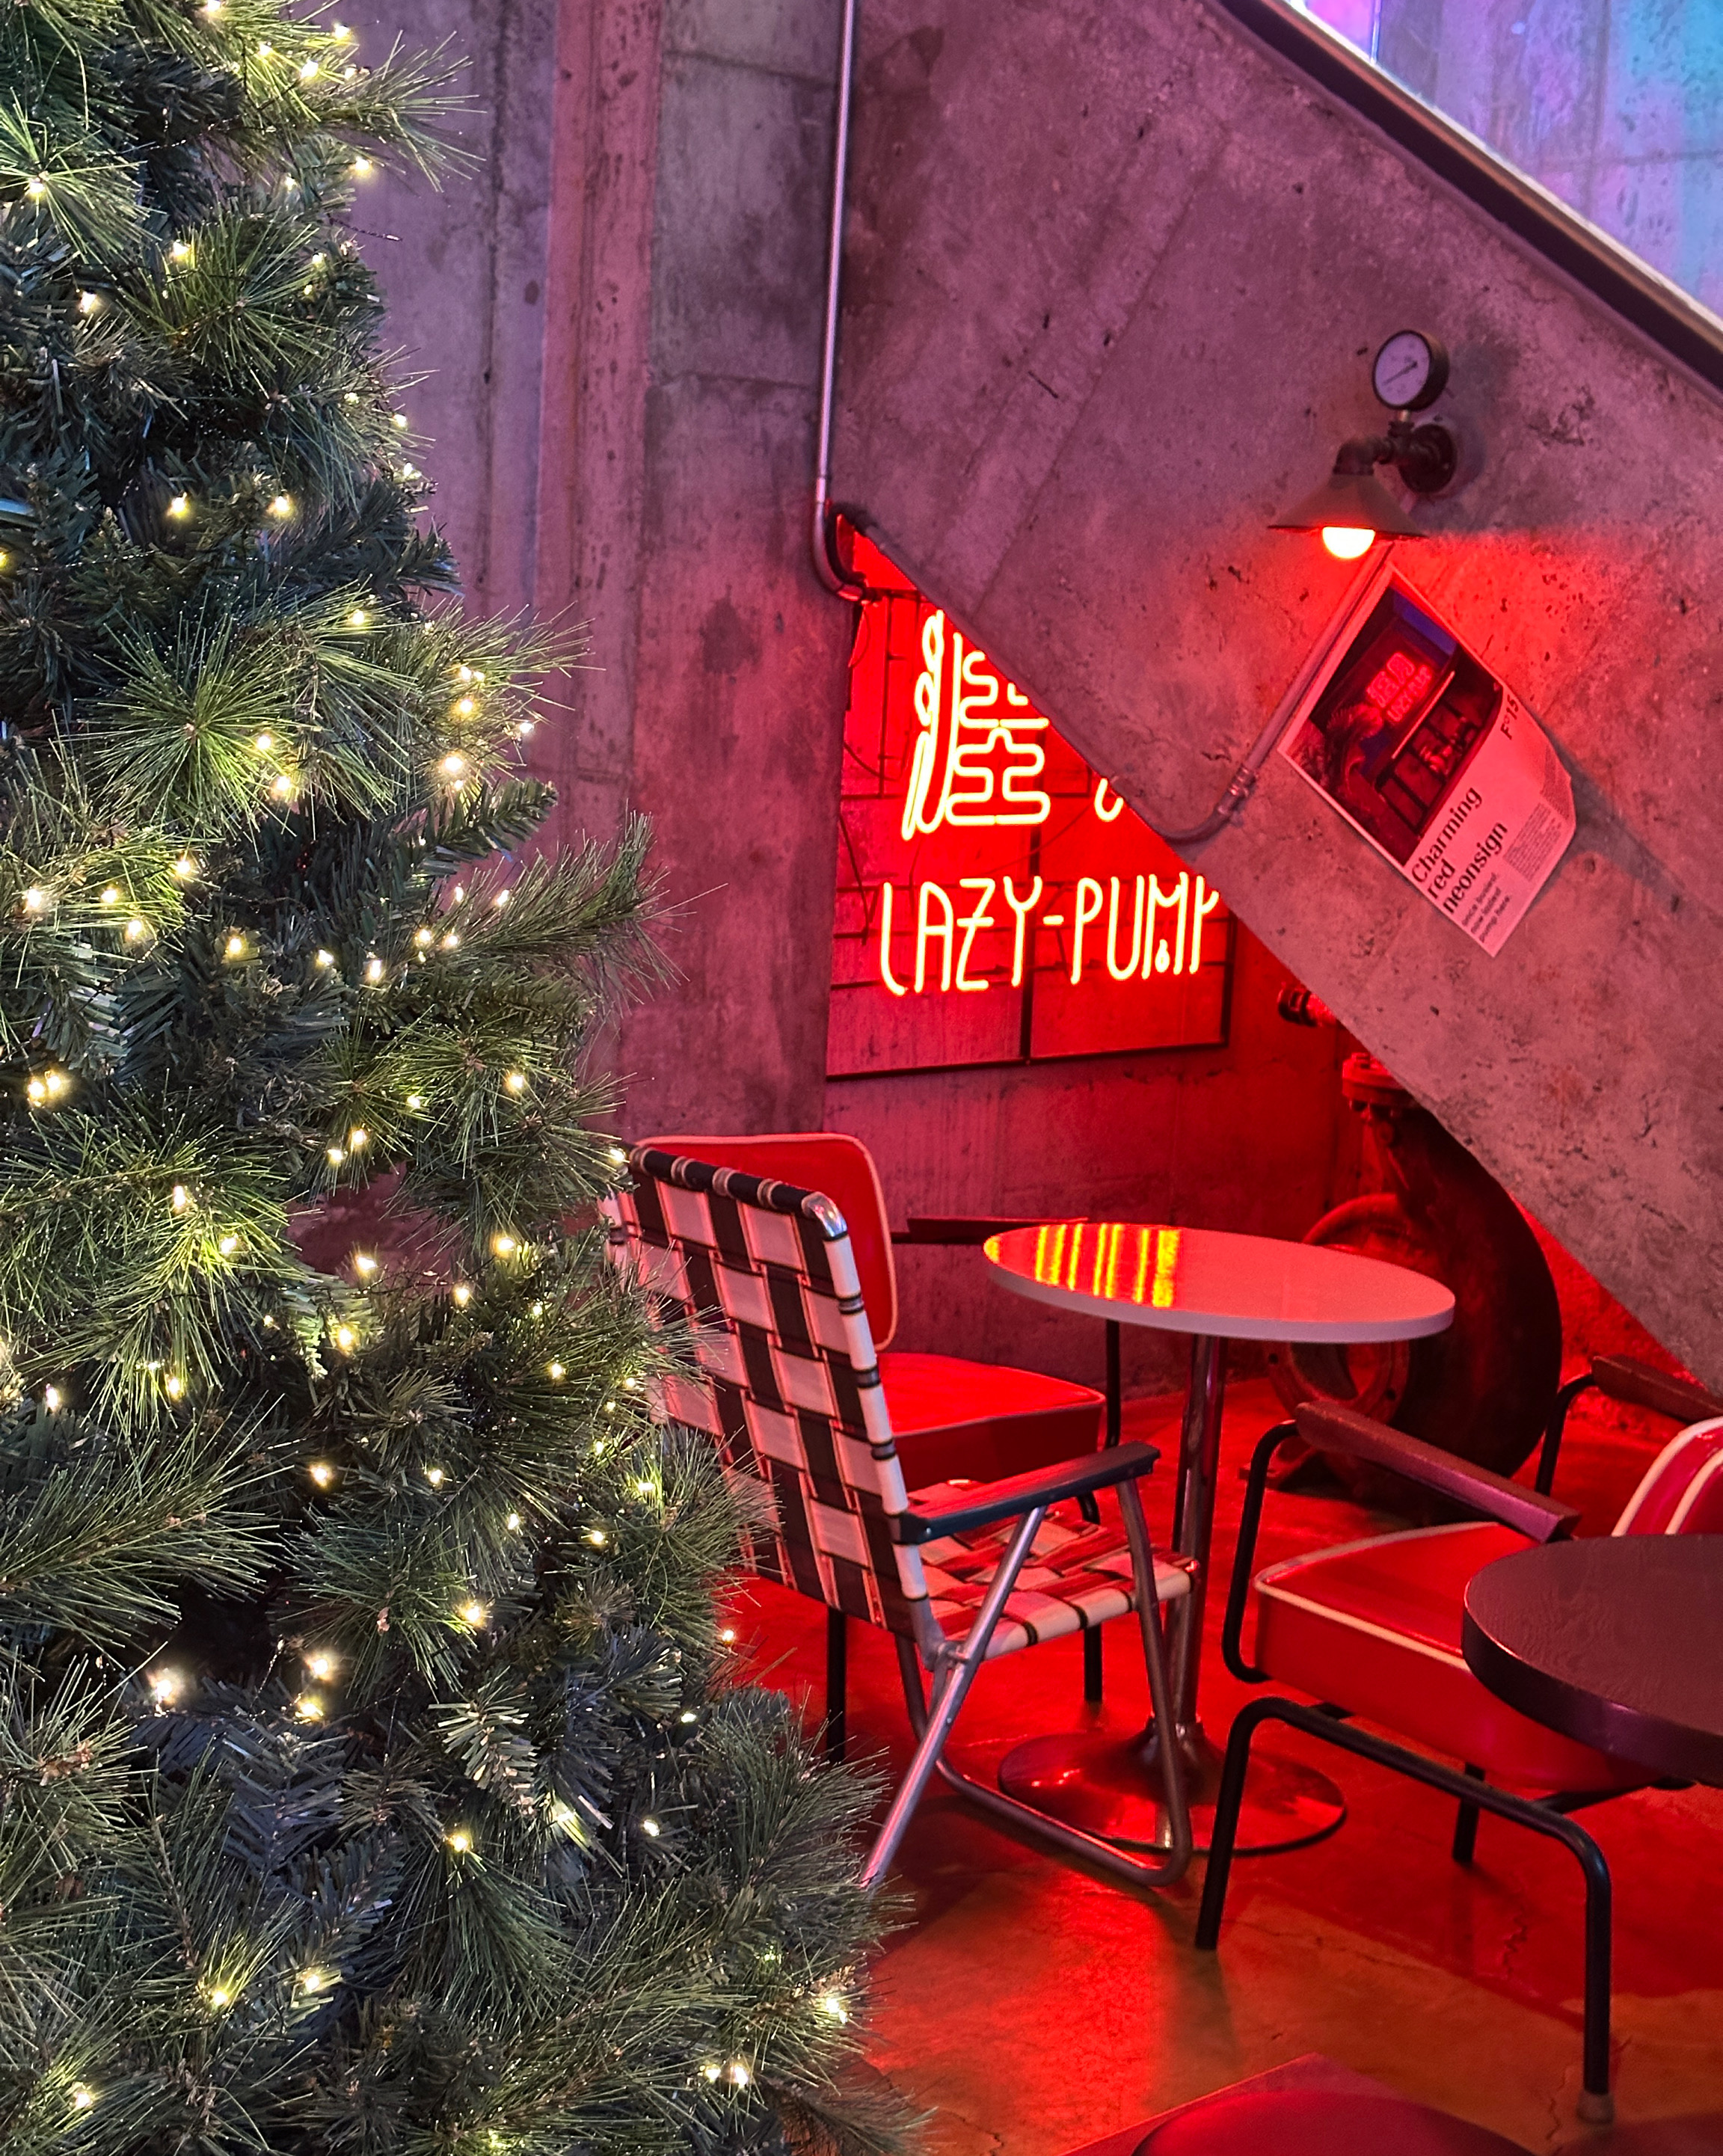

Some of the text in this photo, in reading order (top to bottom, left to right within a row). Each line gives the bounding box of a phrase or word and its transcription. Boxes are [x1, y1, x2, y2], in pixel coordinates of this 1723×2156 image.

[1411, 787, 1482, 882] Charming
[1427, 859, 1455, 899] red
[1443, 822, 1508, 914] neonsign
